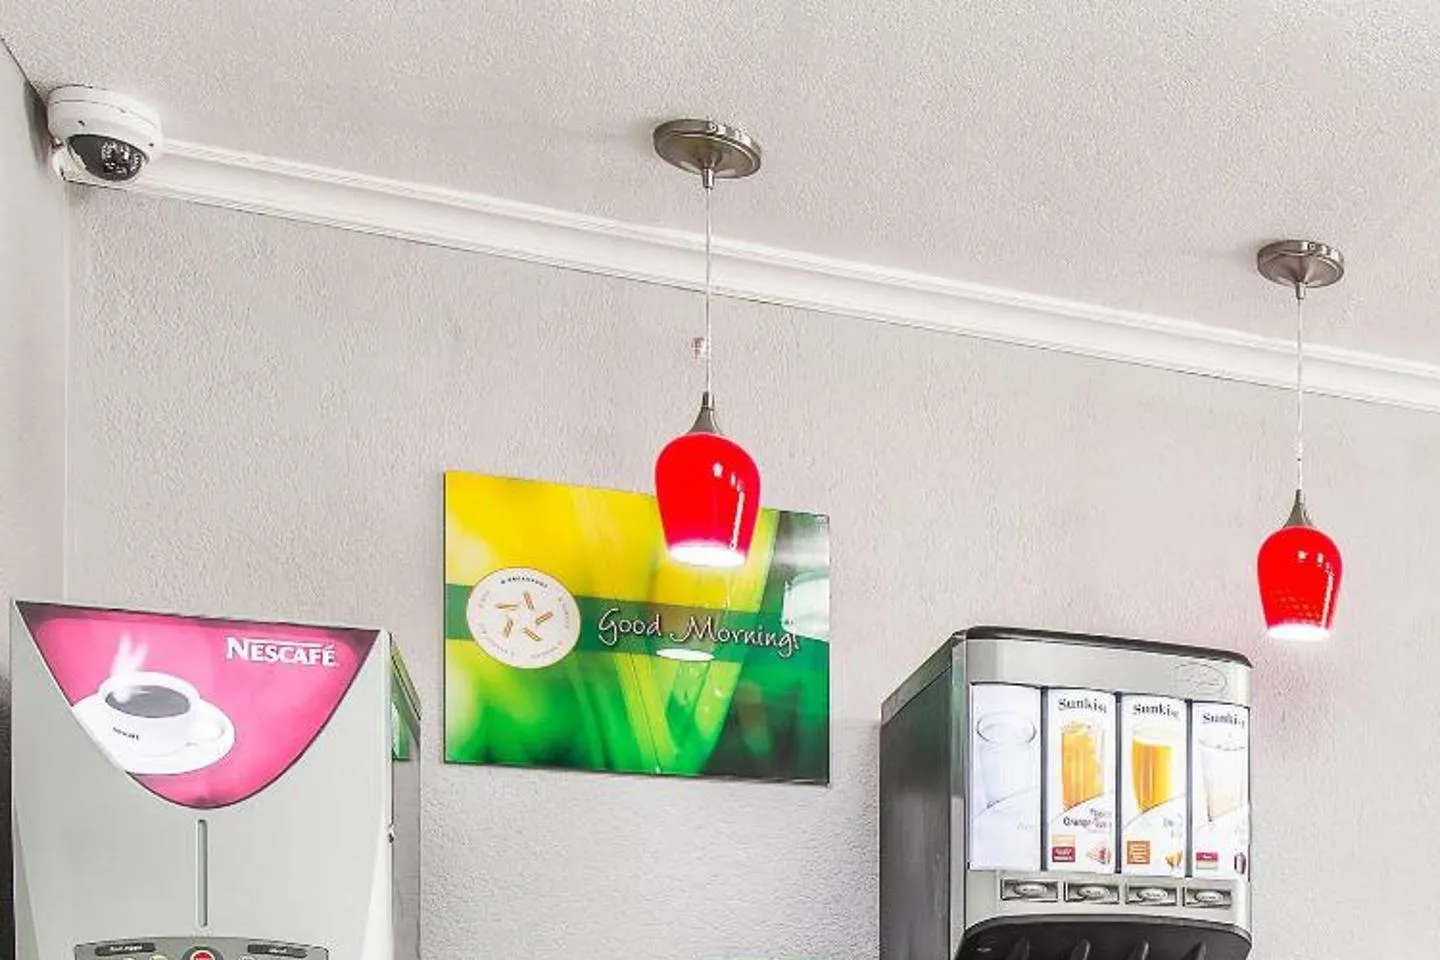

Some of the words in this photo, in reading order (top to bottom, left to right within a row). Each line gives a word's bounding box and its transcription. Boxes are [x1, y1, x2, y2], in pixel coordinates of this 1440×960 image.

[226, 636, 338, 667] NESCAFÉ
[598, 608, 662, 646] Good
[669, 615, 800, 658] Morning!
